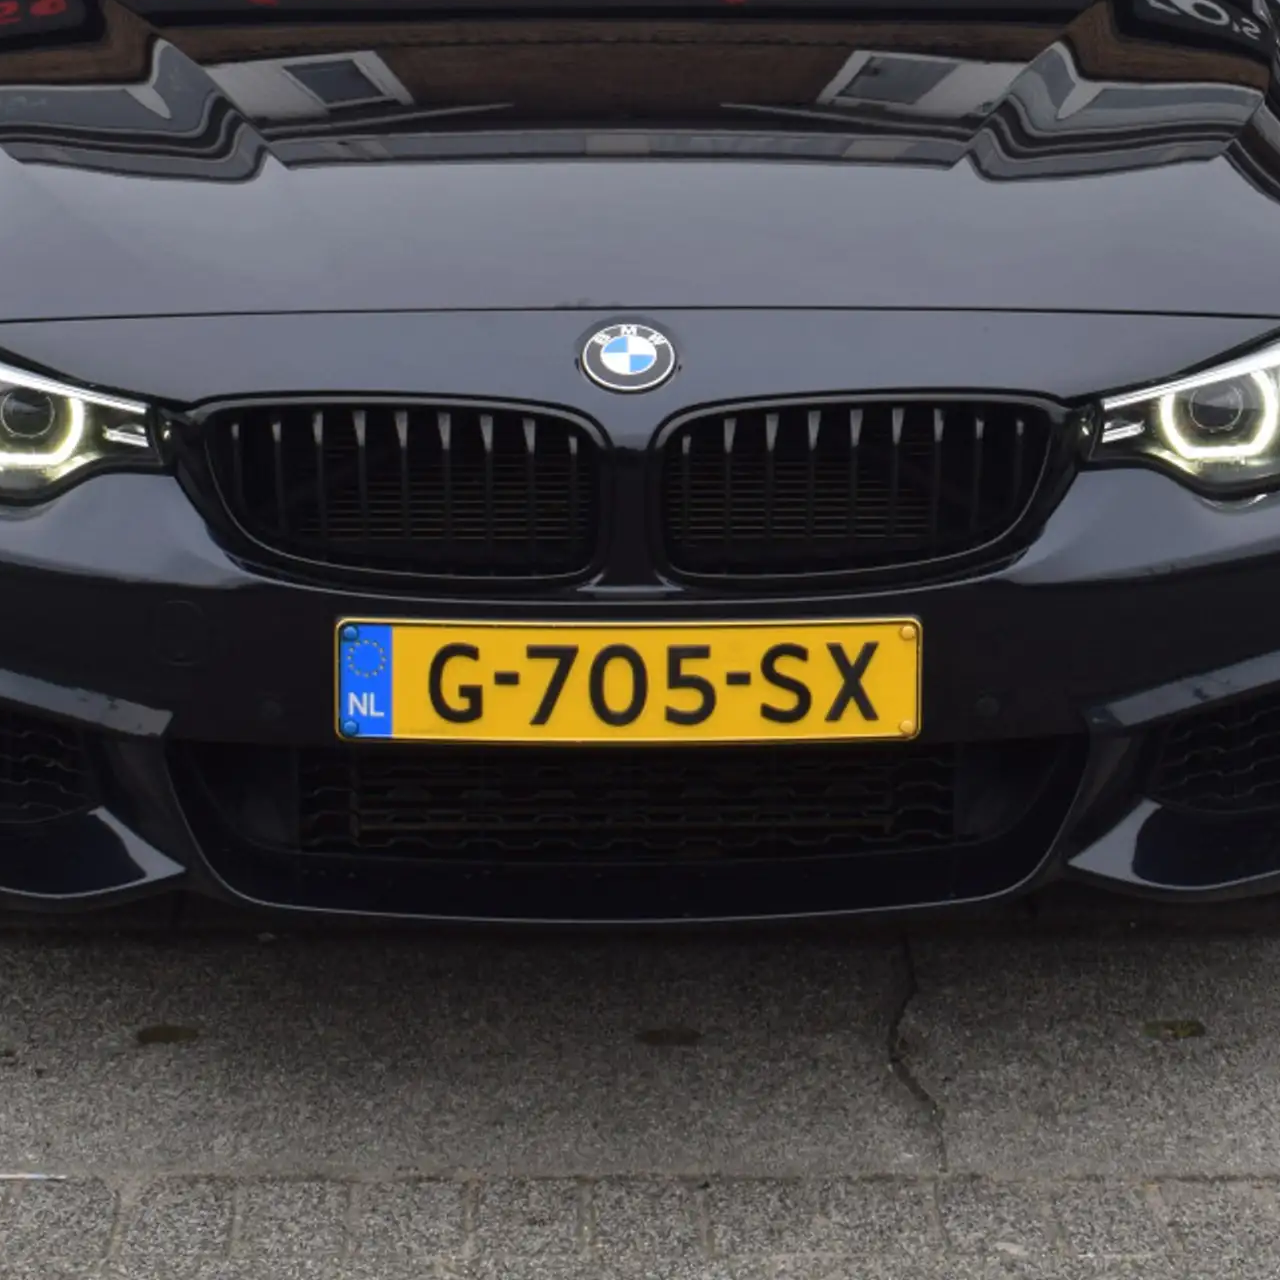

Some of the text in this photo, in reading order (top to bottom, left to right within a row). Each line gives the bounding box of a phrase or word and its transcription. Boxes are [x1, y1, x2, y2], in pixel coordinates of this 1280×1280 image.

[593, 324, 667, 346] BMW
[428, 643, 879, 727] G-705-SX
[348, 692, 385, 718] NL
